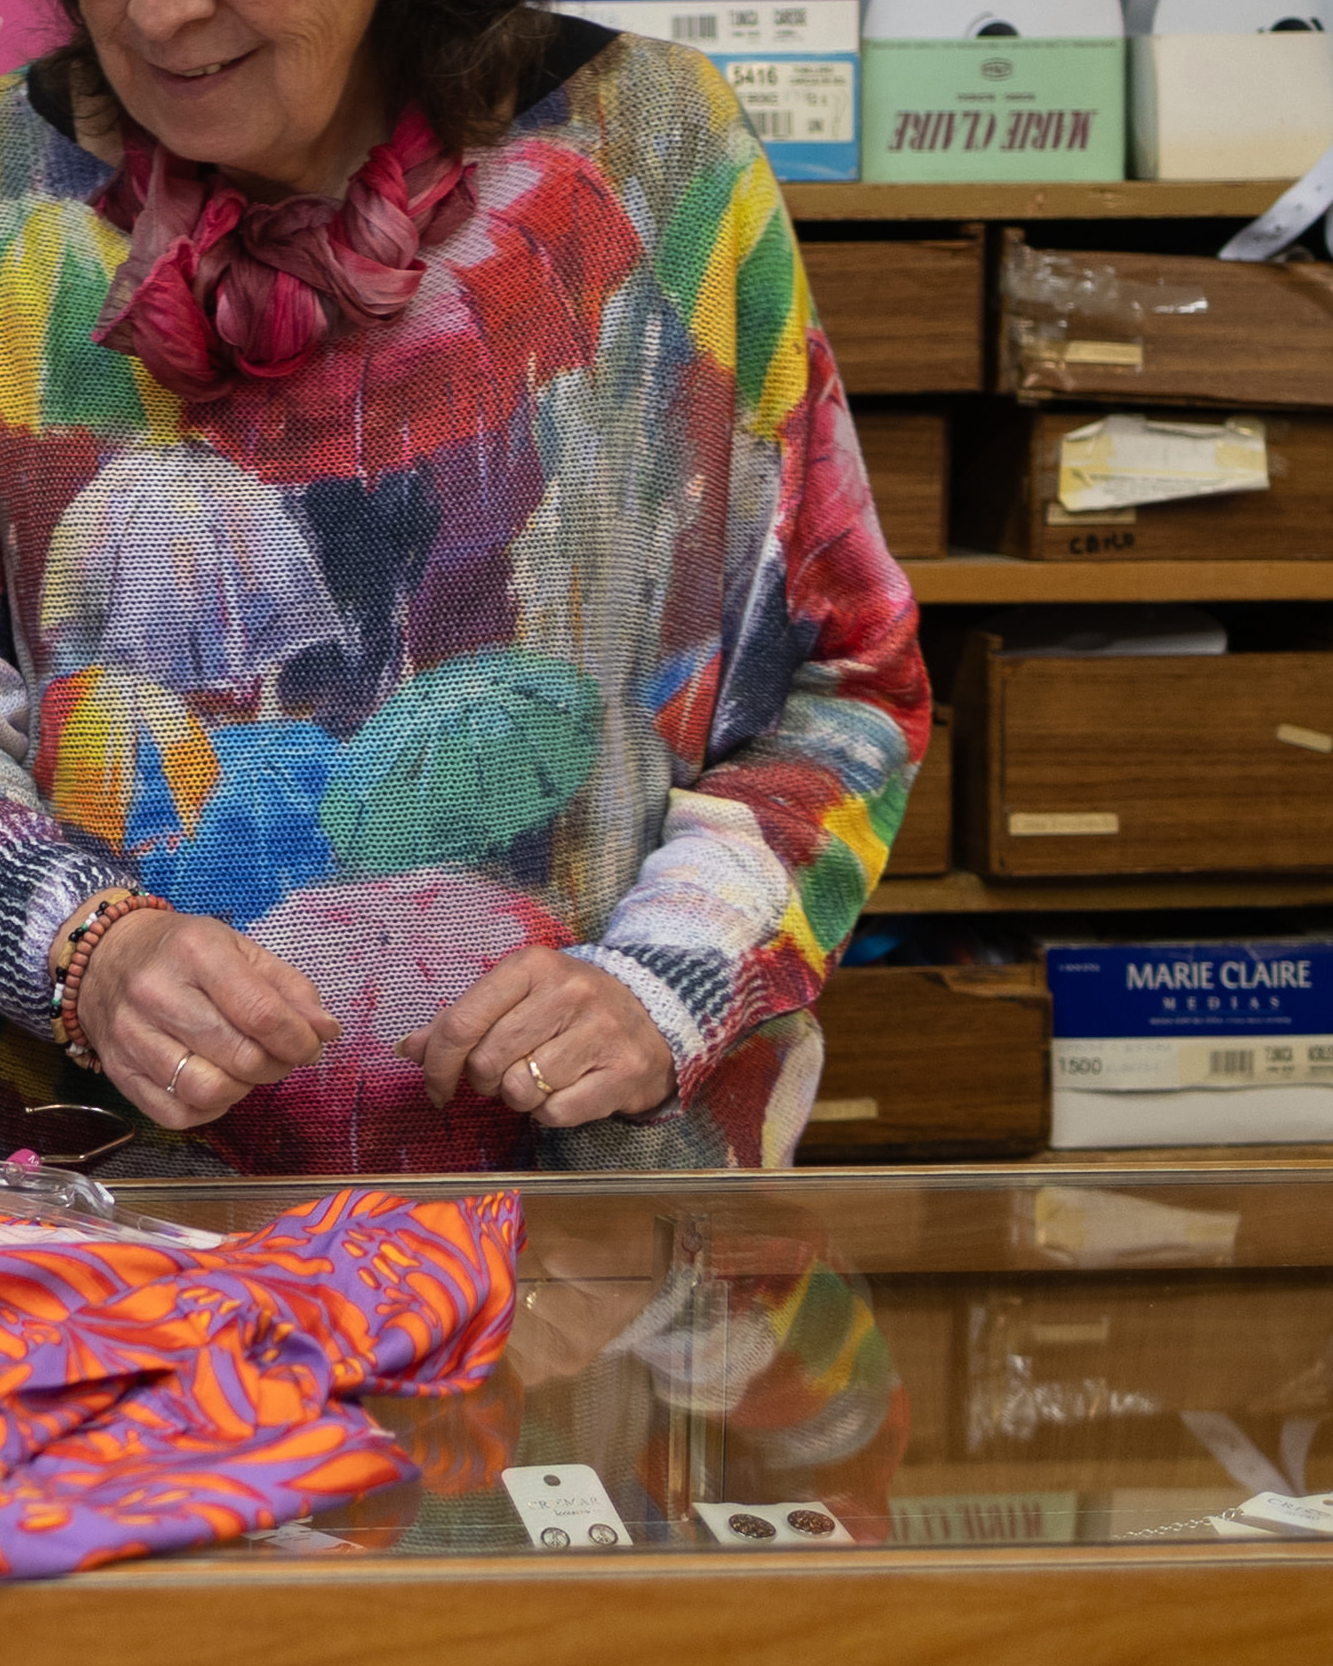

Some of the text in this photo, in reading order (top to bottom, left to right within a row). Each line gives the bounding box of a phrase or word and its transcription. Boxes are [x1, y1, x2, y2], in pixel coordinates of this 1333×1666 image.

[733, 66, 778, 85] 5416
[1126, 960, 1312, 991] MARIE CLAIRE
[1162, 996, 1280, 1010] MEDIAS
